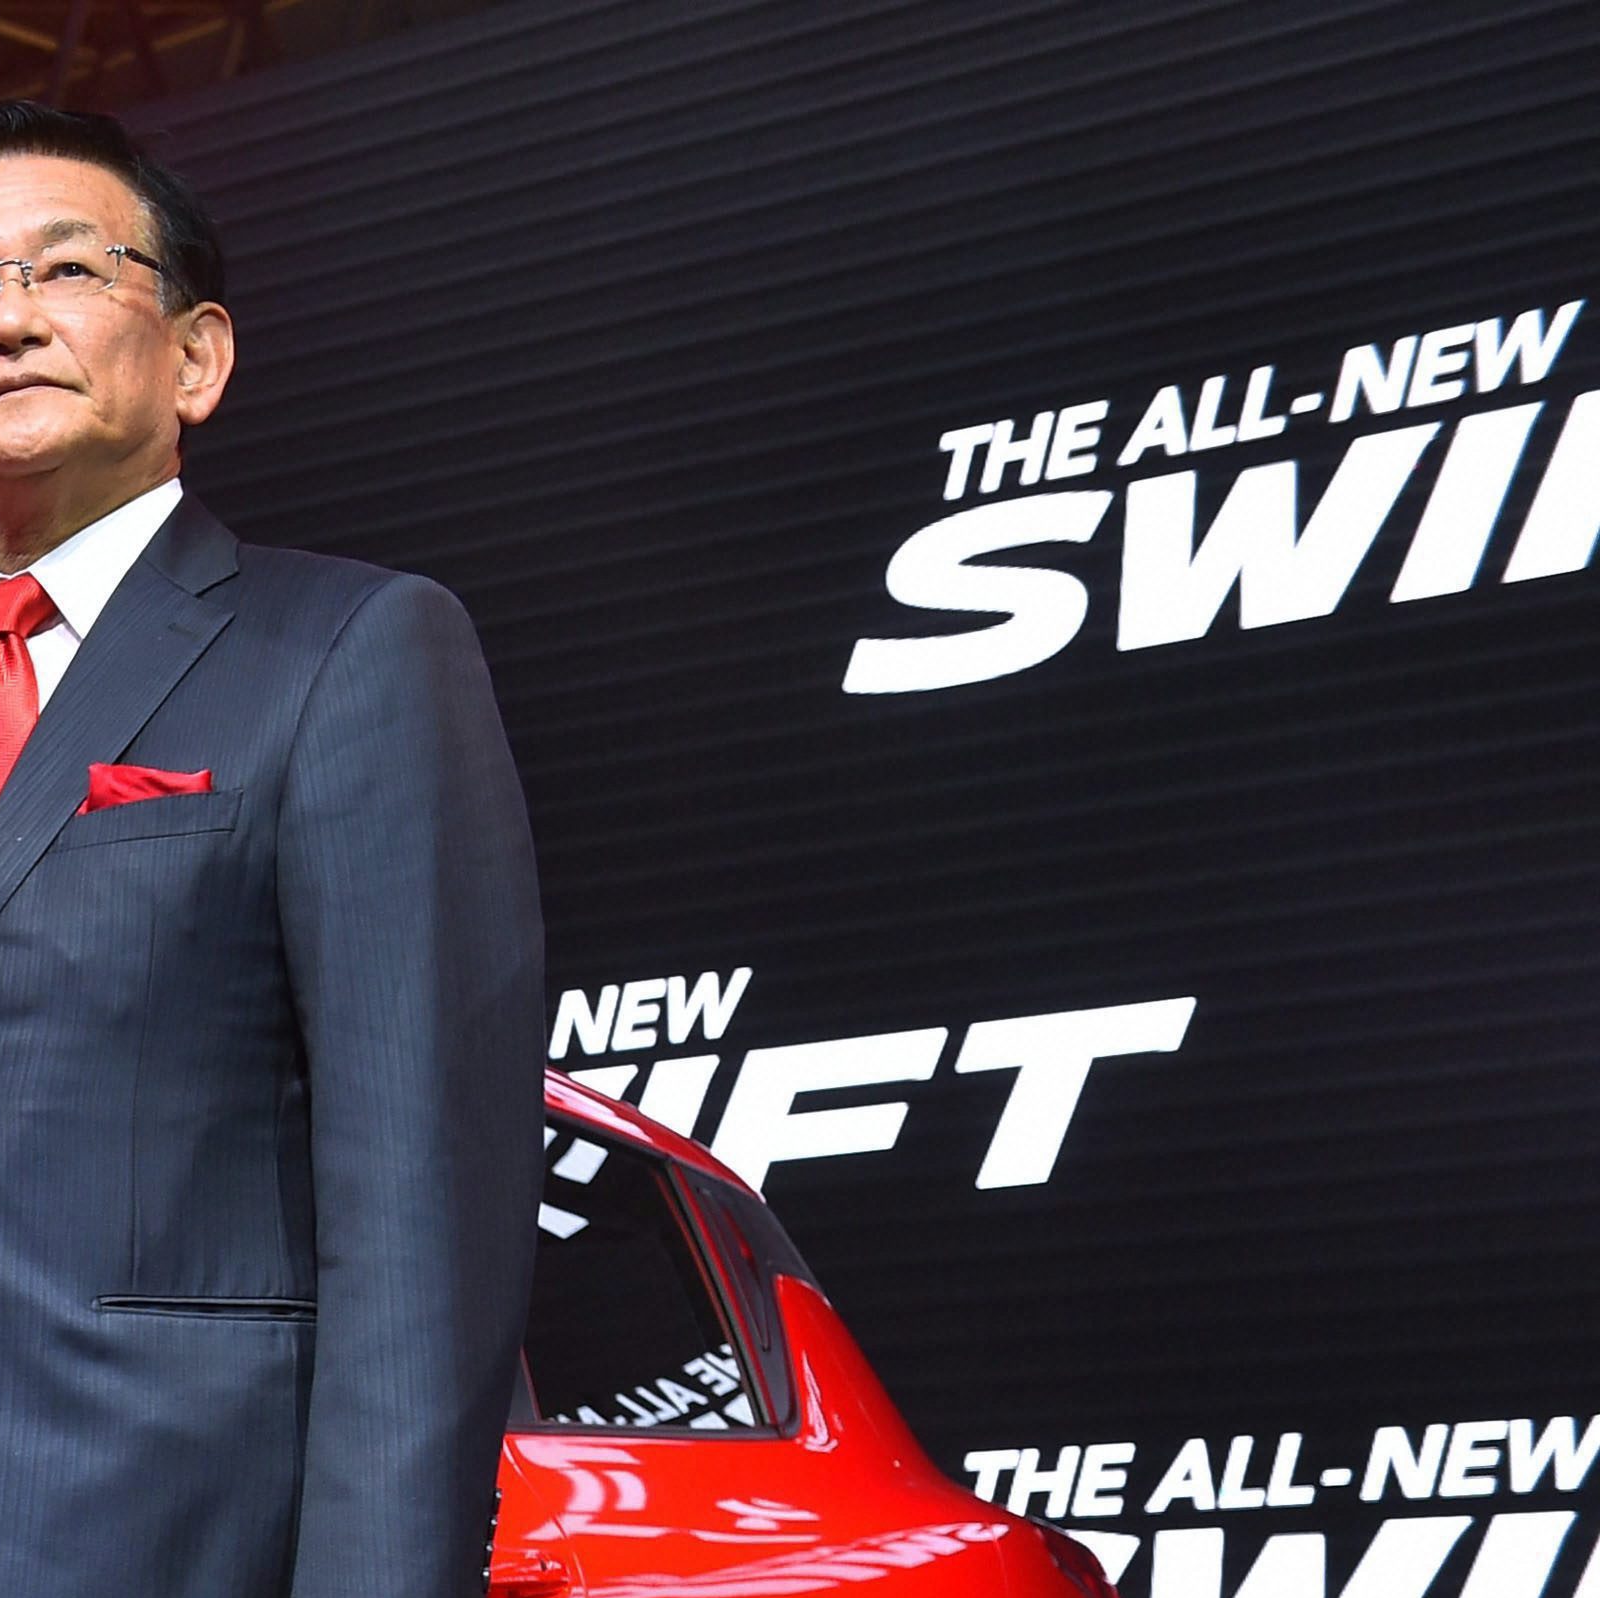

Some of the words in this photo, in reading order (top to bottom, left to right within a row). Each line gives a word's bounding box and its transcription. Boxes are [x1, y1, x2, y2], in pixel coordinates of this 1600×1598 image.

[938, 399, 1110, 502] THE
[1117, 298, 1587, 468] ALL-NEW
[963, 1441, 1137, 1519] THE
[1143, 1413, 1600, 1517] ALL-NEW
